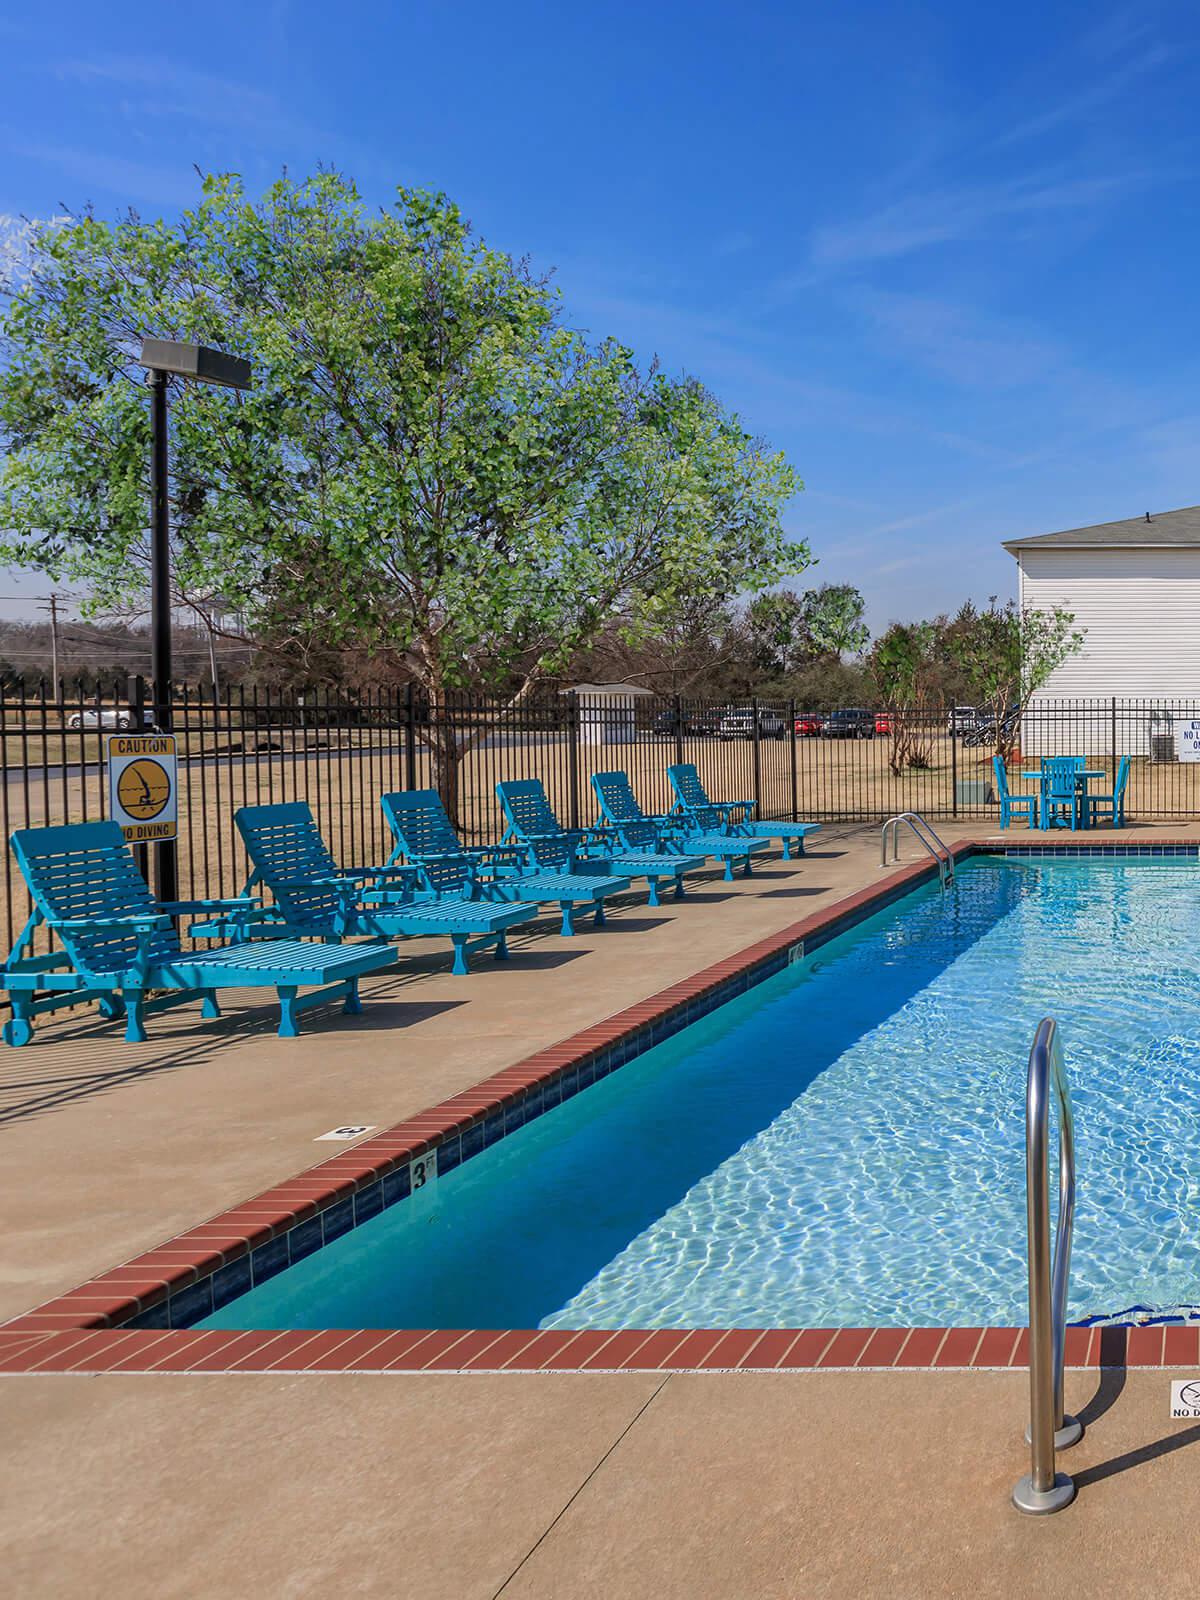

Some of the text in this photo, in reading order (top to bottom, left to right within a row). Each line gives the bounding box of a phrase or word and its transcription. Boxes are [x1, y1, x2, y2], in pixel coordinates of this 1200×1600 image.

[1183, 731, 1193, 739] NO
[118, 739, 167, 753] CAUTION
[123, 824, 169, 839] O DIVING
[414, 1162, 426, 1189] 3
